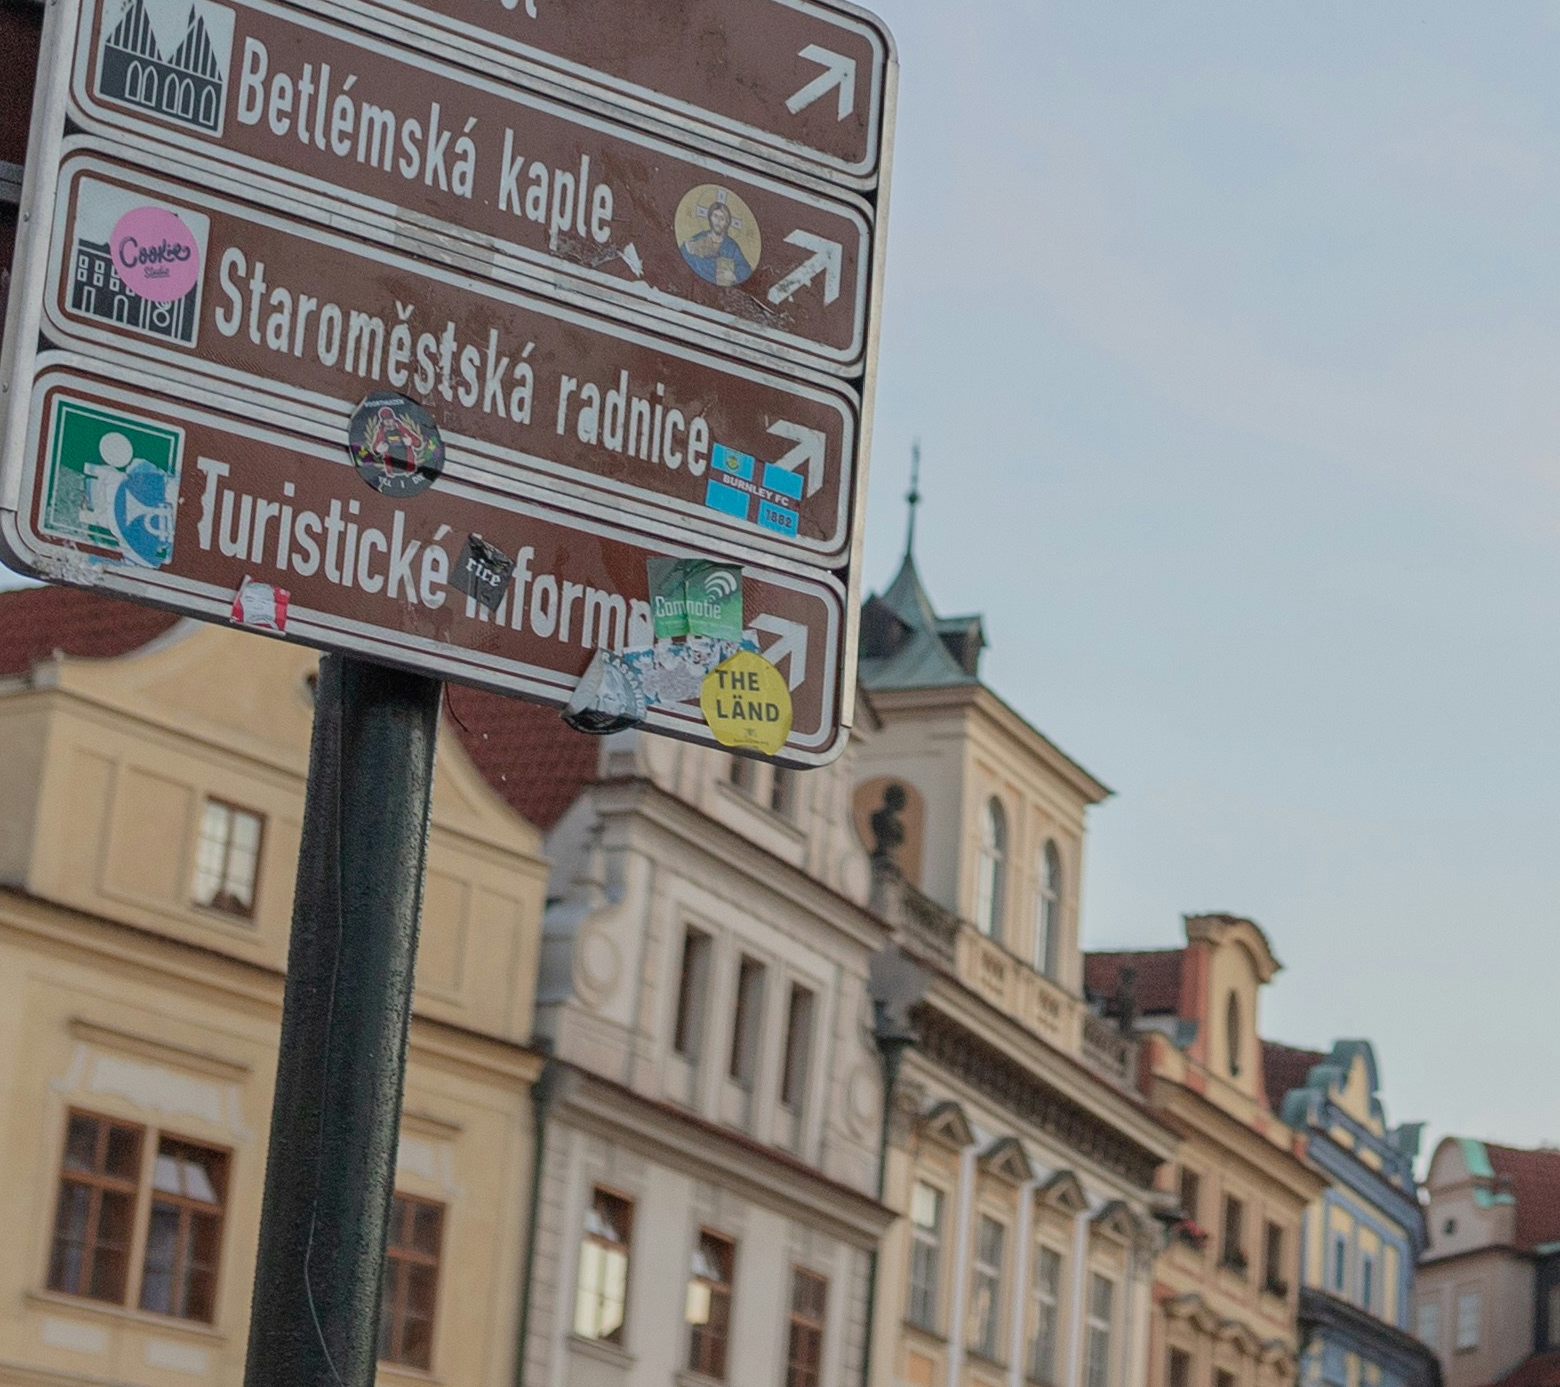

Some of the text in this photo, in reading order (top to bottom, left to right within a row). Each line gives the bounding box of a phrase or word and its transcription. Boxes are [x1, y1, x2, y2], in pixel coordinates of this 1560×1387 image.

[237, 36, 614, 251] Betlémská kaple
[214, 246, 710, 477] Staroměstská radnice
[722, 473, 789, 507] BURNLEY FC
[765, 508, 792, 528] 1882
[196, 456, 655, 655] Turistické forma
[465, 557, 502, 587] rice
[715, 669, 760, 692] THE
[716, 694, 780, 722] LÄND
